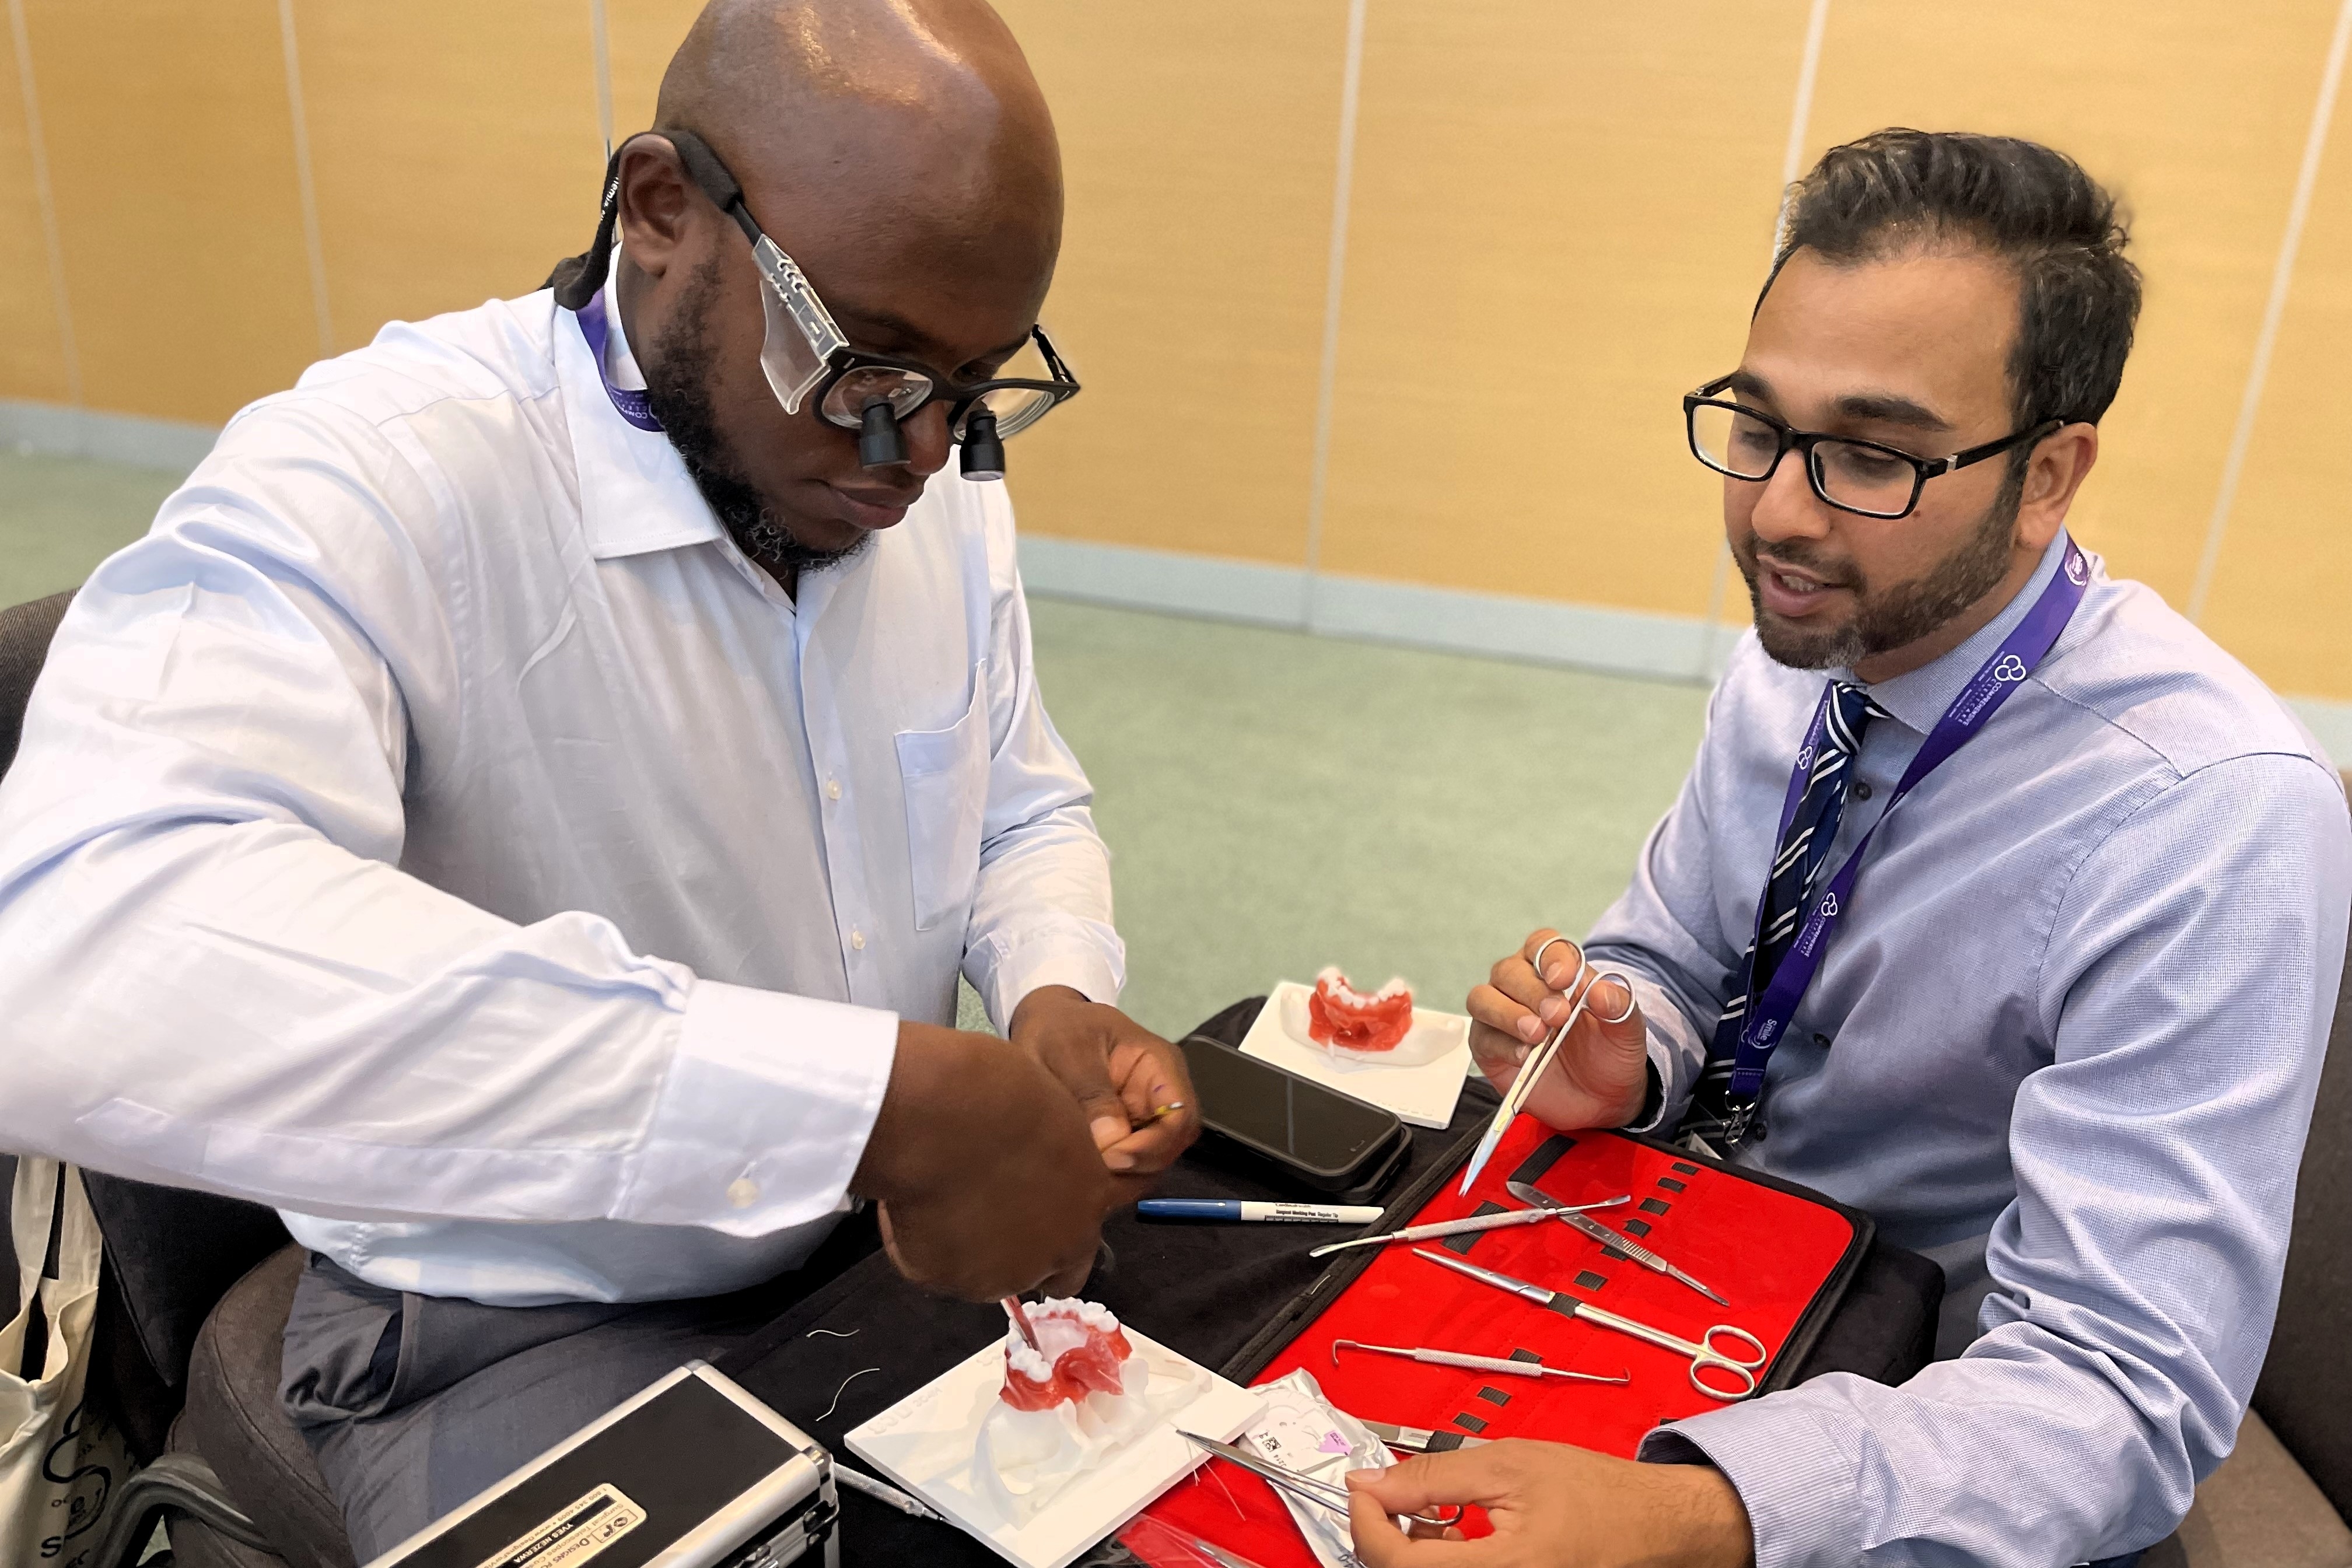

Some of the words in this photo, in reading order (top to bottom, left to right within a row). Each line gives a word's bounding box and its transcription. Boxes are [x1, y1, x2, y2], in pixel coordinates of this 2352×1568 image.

[1760, 1019, 1777, 1041] Smile
[592, 1503, 624, 1526] Surgical
[547, 1526, 591, 1556] Telescopes
[551, 1523, 573, 1538] YVES
[513, 1536, 552, 1563] NEZERWA
